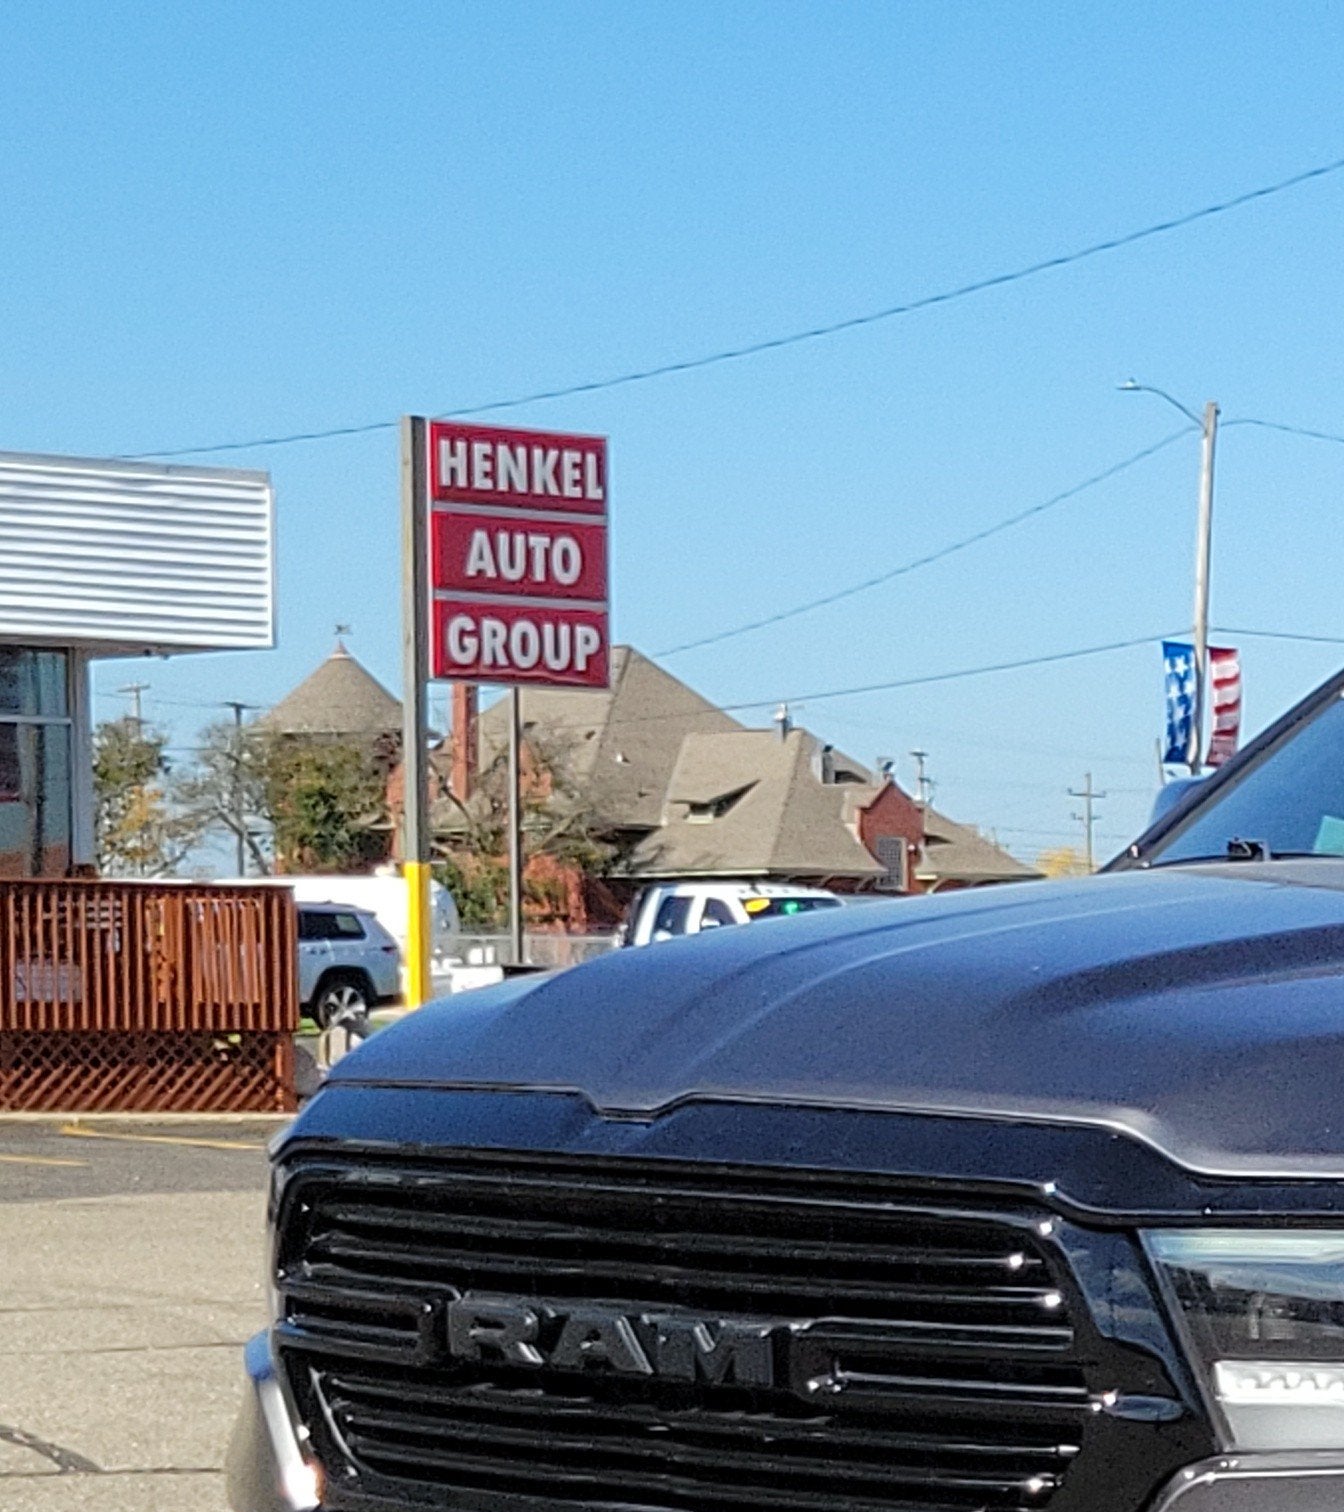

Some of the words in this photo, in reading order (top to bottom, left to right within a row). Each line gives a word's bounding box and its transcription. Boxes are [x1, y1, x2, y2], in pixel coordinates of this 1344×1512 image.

[438, 438, 604, 499] HENKEL
[465, 528, 583, 586] AUTO
[447, 613, 602, 671] GROUP
[448, 1293, 774, 1388] RAM
